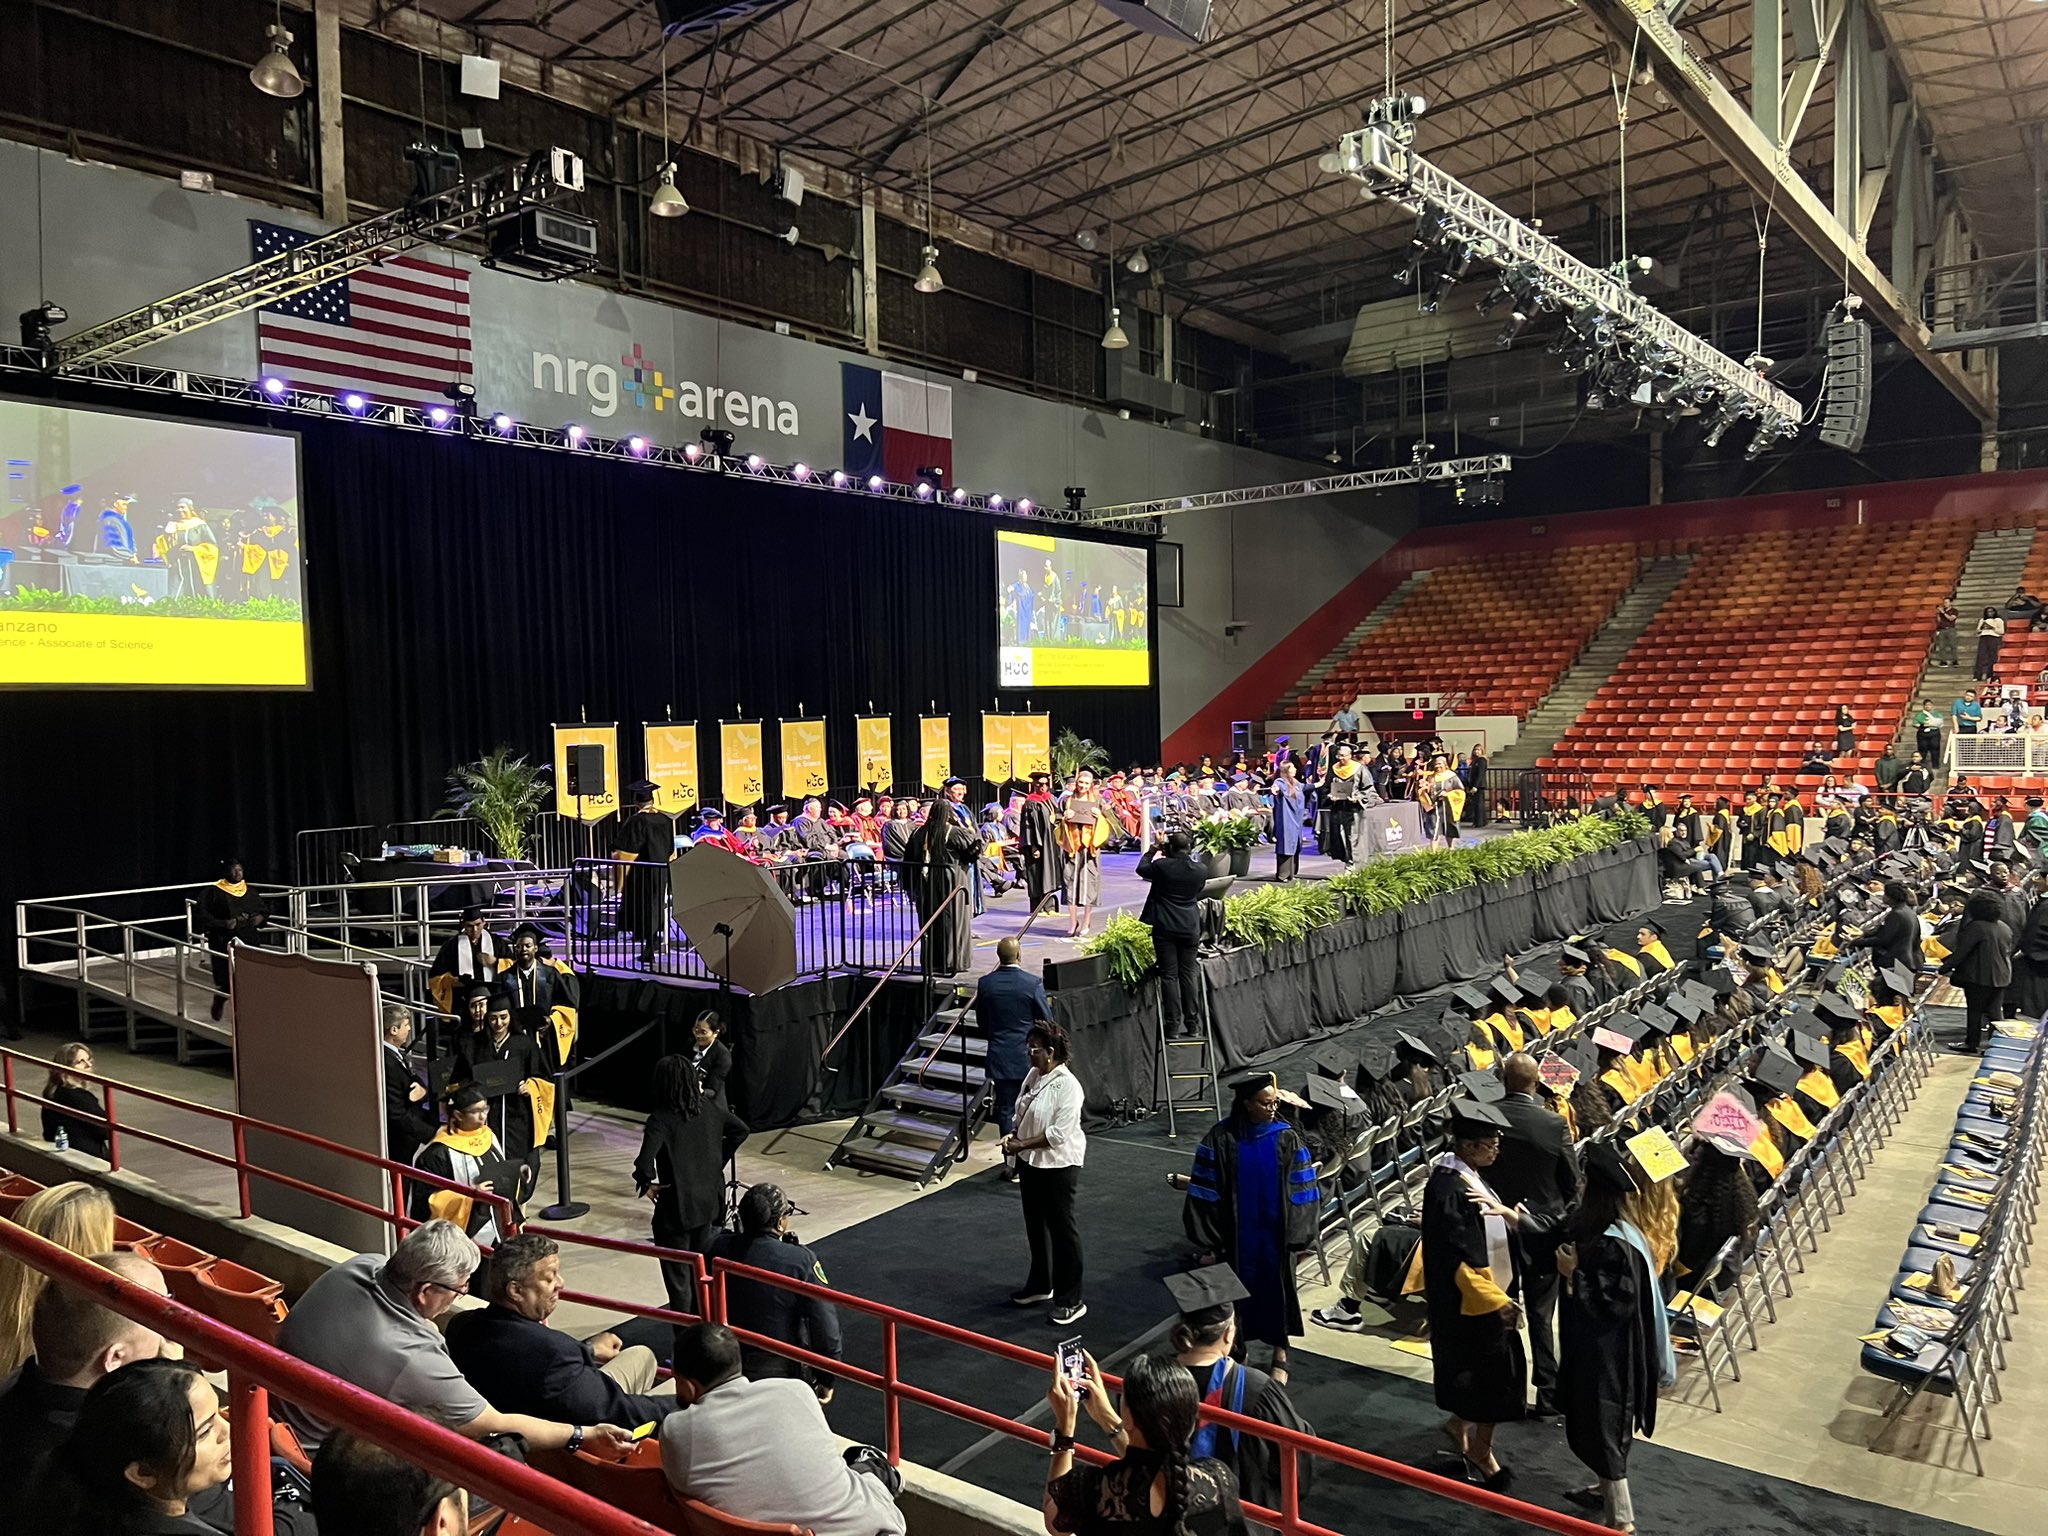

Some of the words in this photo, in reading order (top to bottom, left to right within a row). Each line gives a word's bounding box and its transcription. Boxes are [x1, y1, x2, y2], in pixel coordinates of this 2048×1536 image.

[532, 351, 618, 418] nrg
[678, 380, 799, 436] arena
[38, 638, 93, 648] Associate
[96, 639, 107, 648] of
[110, 640, 154, 650] Science
[1004, 662, 1029, 676] HCC
[743, 782, 761, 793] HCC
[806, 777, 825, 788] HCC
[588, 793, 614, 805] HCC
[672, 788, 695, 799] HCC
